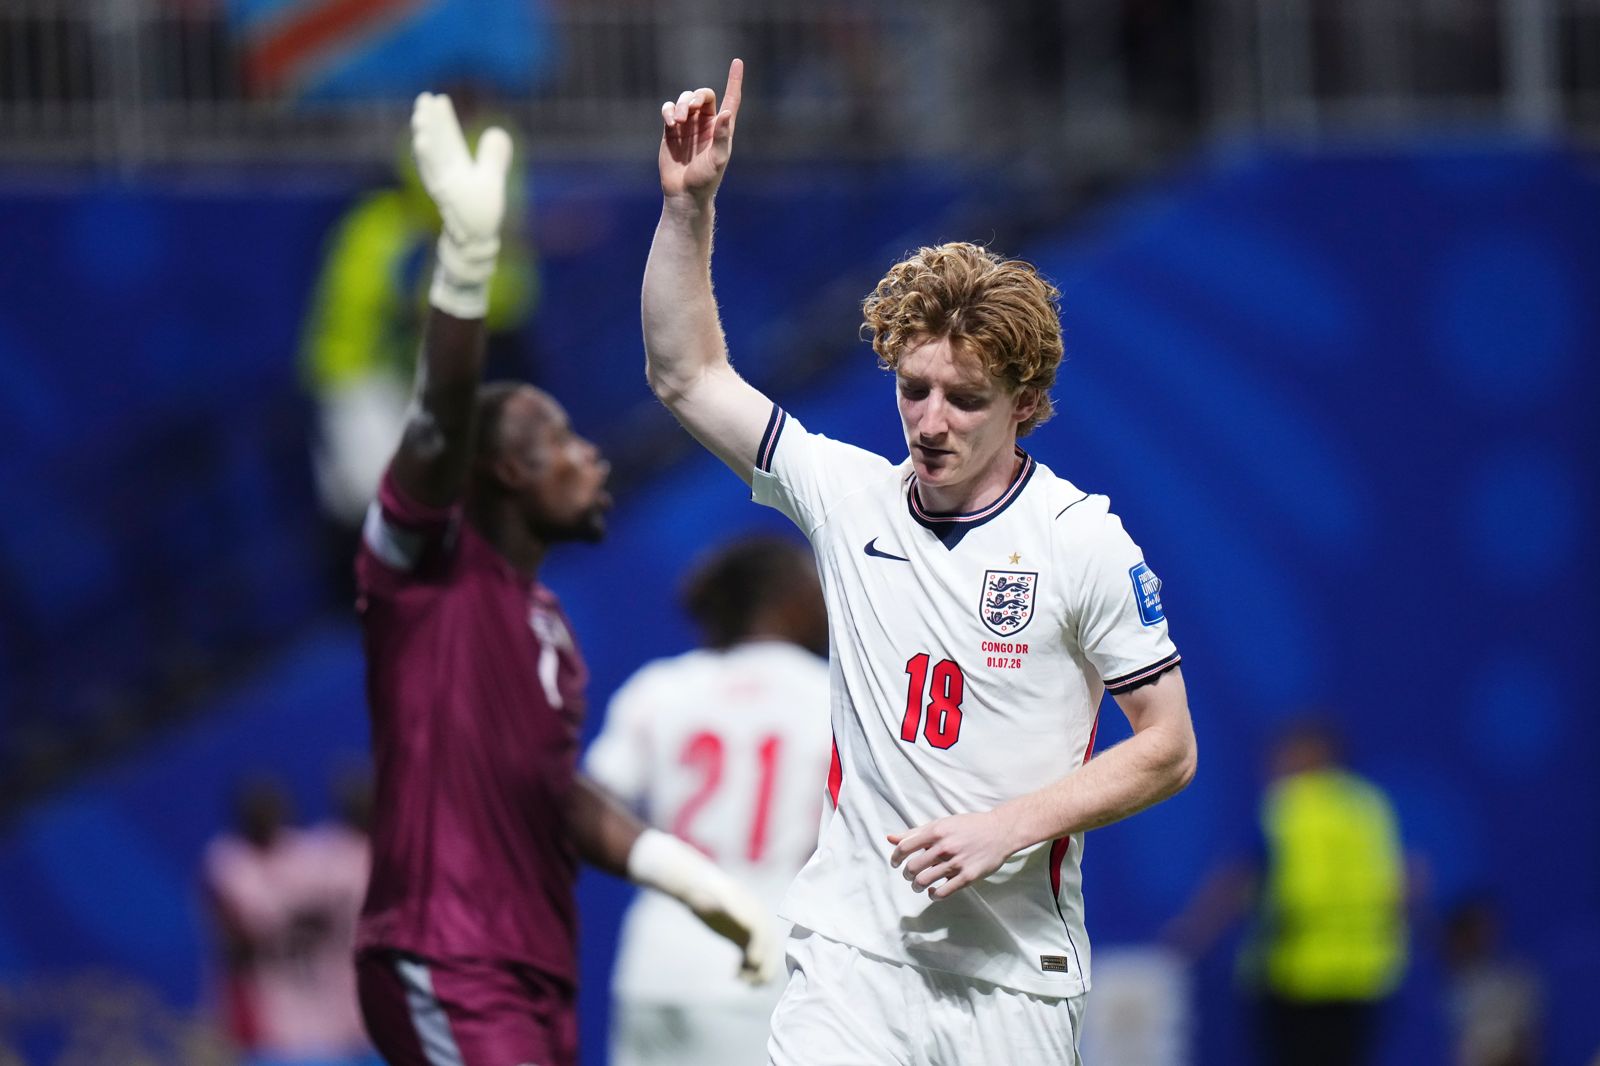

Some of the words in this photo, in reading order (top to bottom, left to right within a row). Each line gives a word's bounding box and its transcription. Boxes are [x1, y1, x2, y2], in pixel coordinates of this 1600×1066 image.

[981, 641, 1013, 654] CONGO
[1015, 643, 1028, 654] DR
[986, 656, 1021, 669] 01.07.26
[900, 652, 964, 750] 18
[670, 730, 781, 863] 21
